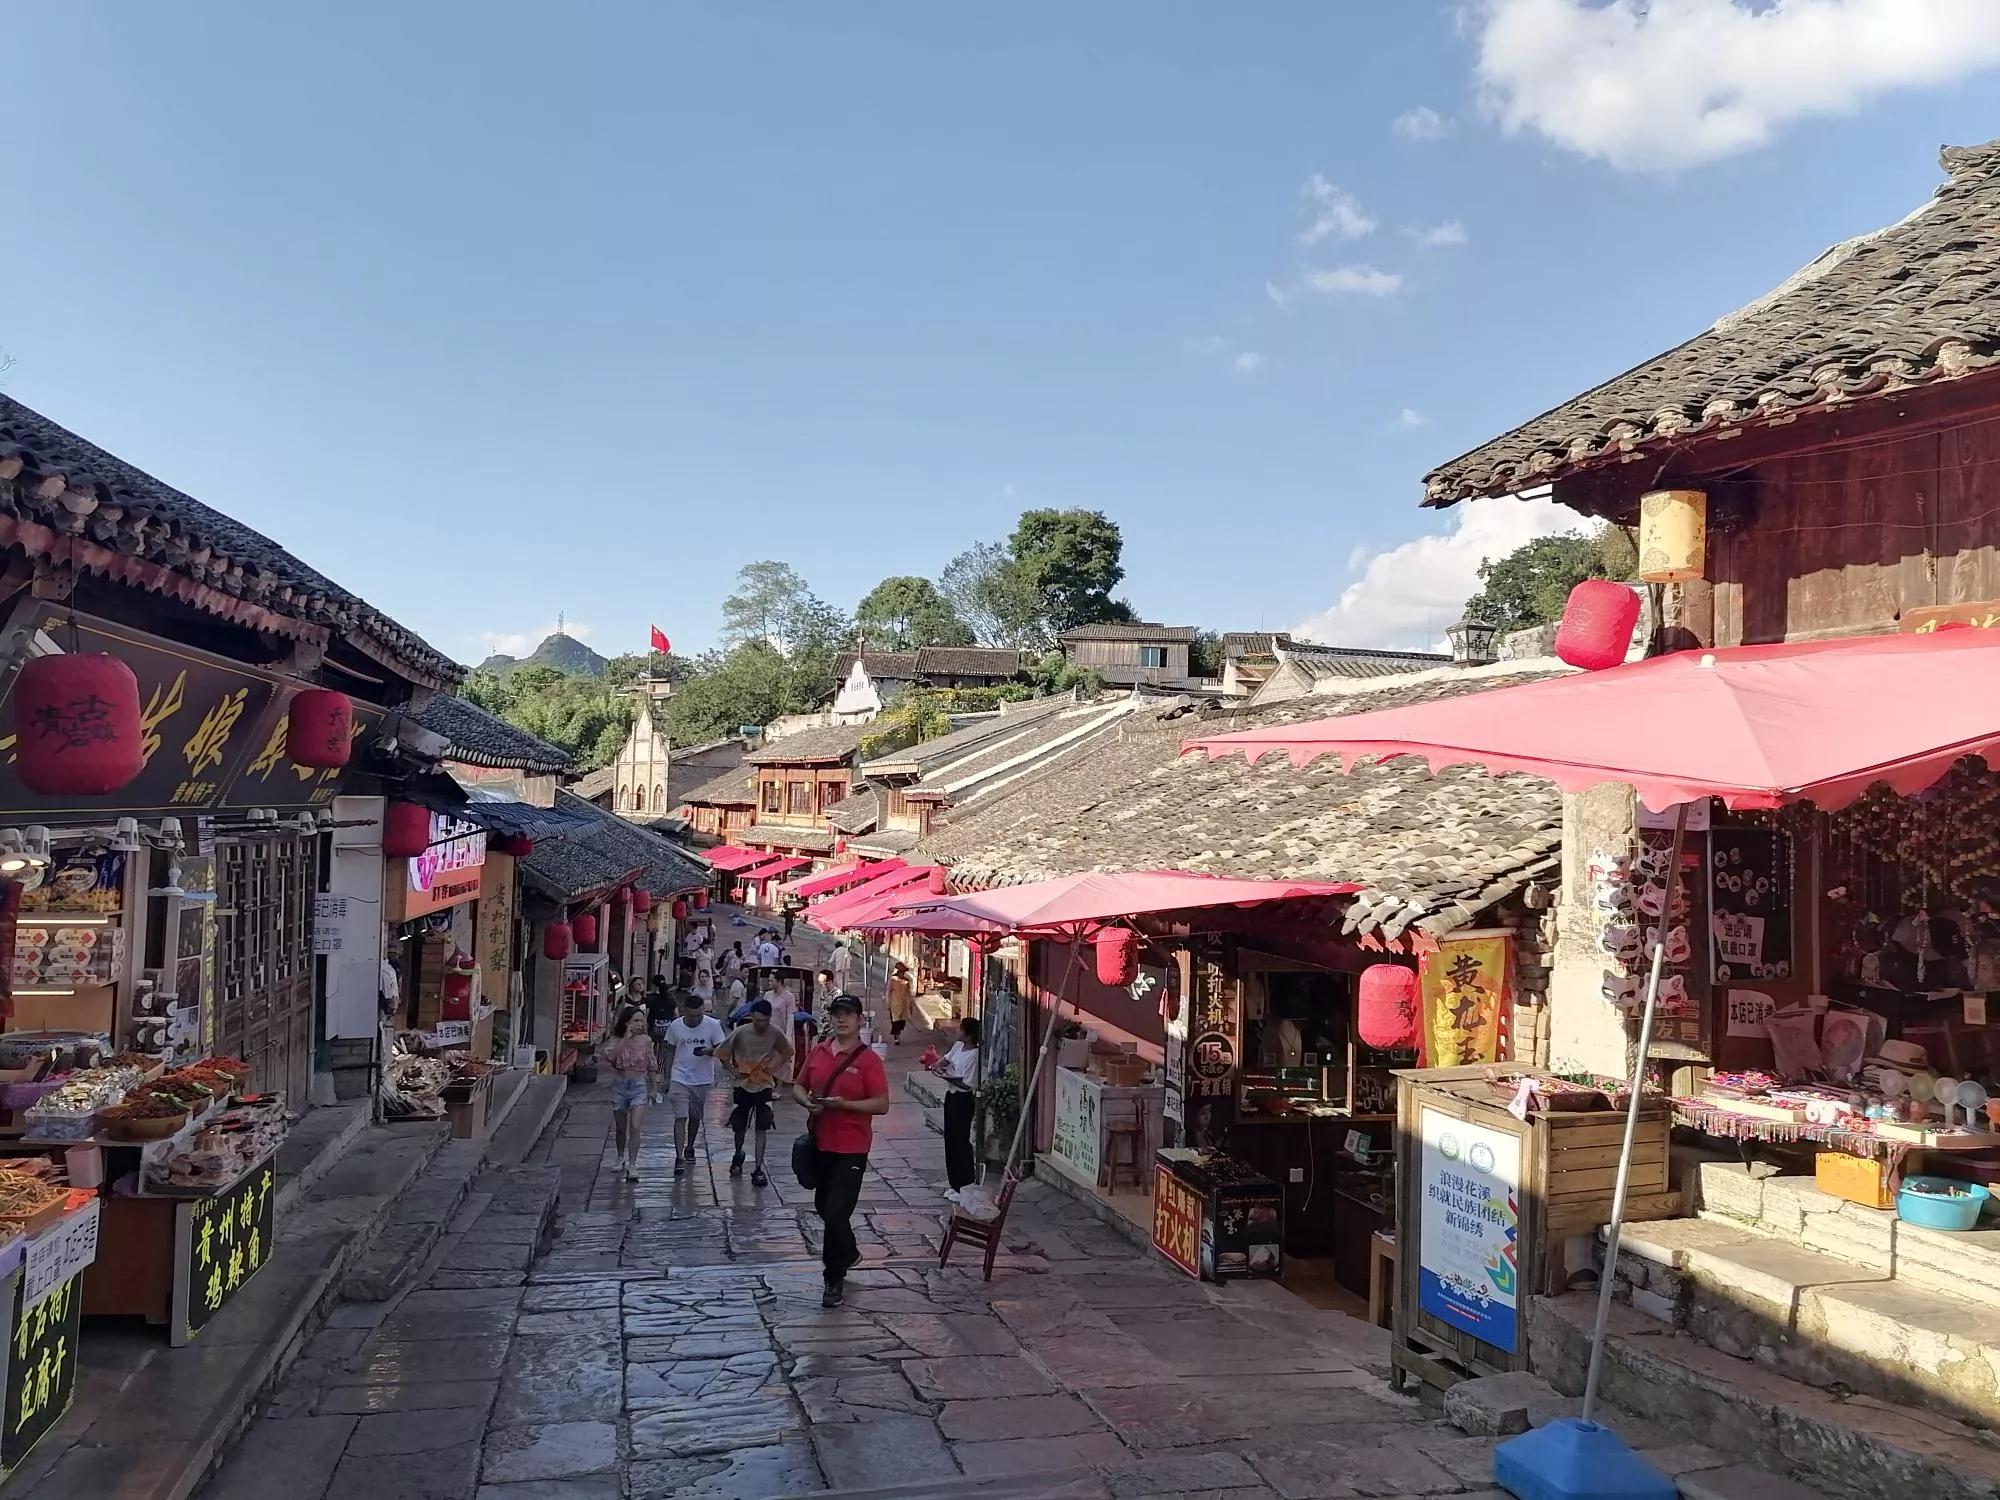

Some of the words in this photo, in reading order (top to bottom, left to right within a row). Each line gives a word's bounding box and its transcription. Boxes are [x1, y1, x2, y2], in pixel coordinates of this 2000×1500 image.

[1190, 1078, 1232, 1097] 厂家直销
[1428, 1183, 1506, 1228] 织就民族团结
[1439, 1168, 1492, 1203] 浪漫花溪
[195, 1169, 272, 1272] 贵州特产
[1155, 1202, 1197, 1267] 打火机
[1445, 1211, 1484, 1238] 新锦绣
[15, 1335, 67, 1435] 豆腐干
